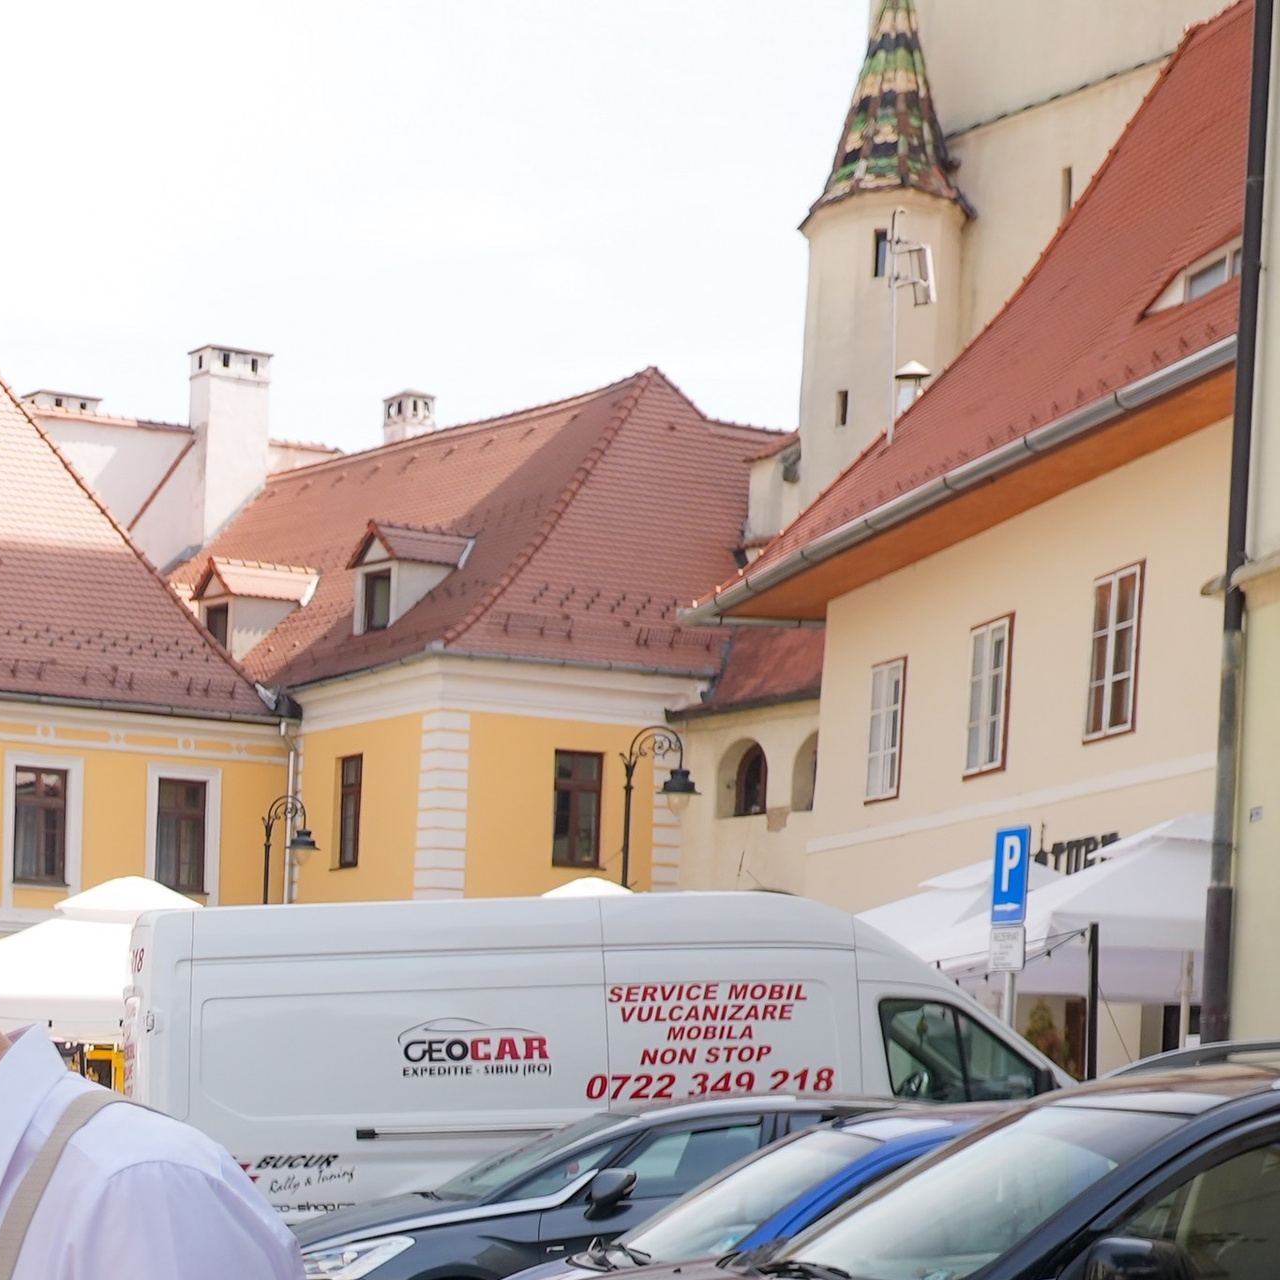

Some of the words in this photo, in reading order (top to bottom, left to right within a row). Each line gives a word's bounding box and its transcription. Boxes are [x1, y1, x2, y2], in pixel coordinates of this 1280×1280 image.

[1001, 835, 1021, 892] P
[608, 984, 719, 1003] SERVICE
[727, 984, 808, 1001] MOBIL
[620, 1004, 794, 1022] VULCANIZARE
[667, 1025, 753, 1040] MOBILA
[640, 1049, 697, 1065] NON
[705, 1046, 771, 1063] STOP
[402, 1065, 472, 1077] EXPEDITIE
[483, 1064, 519, 1075] SIBIU
[523, 1062, 552, 1077] (RO)
[586, 1073, 676, 1100] 0722
[689, 1072, 755, 1098] 349
[770, 1068, 834, 1092] 218
[256, 1154, 339, 1170] BUCUR
